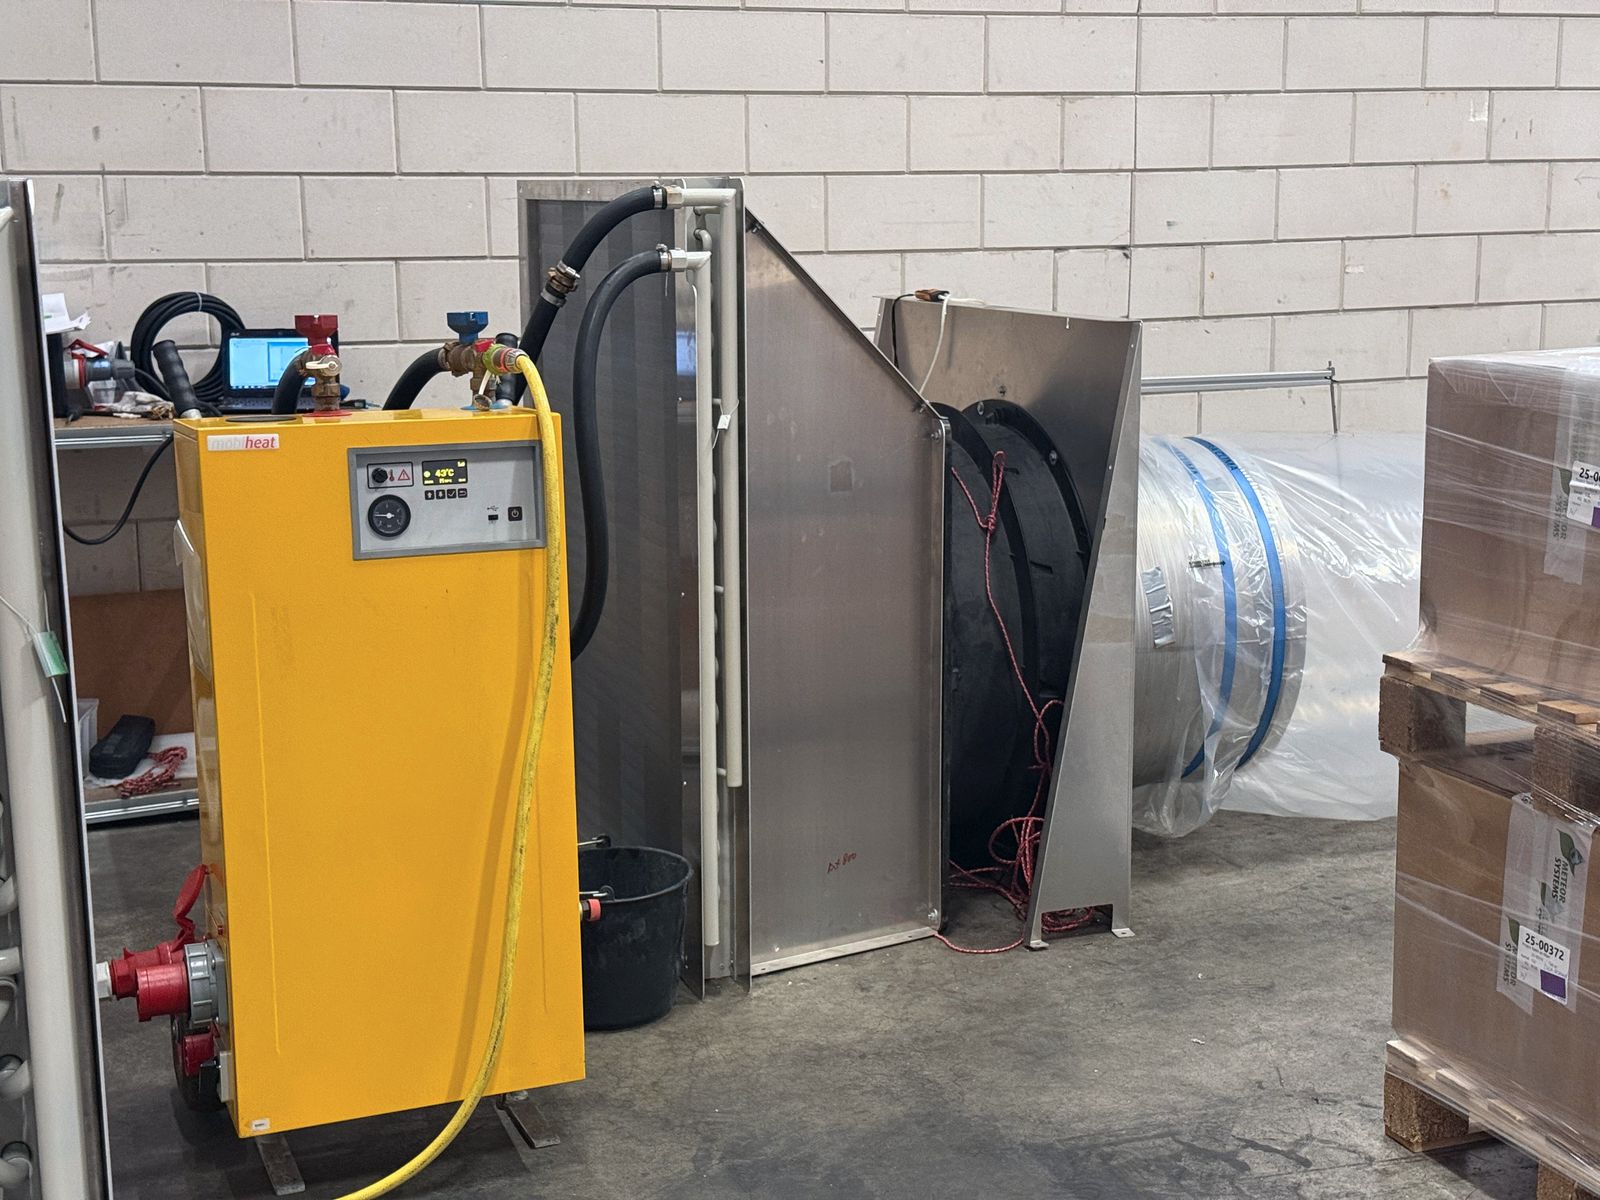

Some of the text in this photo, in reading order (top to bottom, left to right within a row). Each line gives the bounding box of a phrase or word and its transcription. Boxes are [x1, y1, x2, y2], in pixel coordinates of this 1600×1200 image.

[211, 436, 275, 449] mobiheat
[1579, 467, 1600, 482] 25-0
[1551, 857, 1562, 902] SYSTEMS
[1558, 860, 1569, 903] METEOR
[1525, 933, 1565, 961] 25-00372
